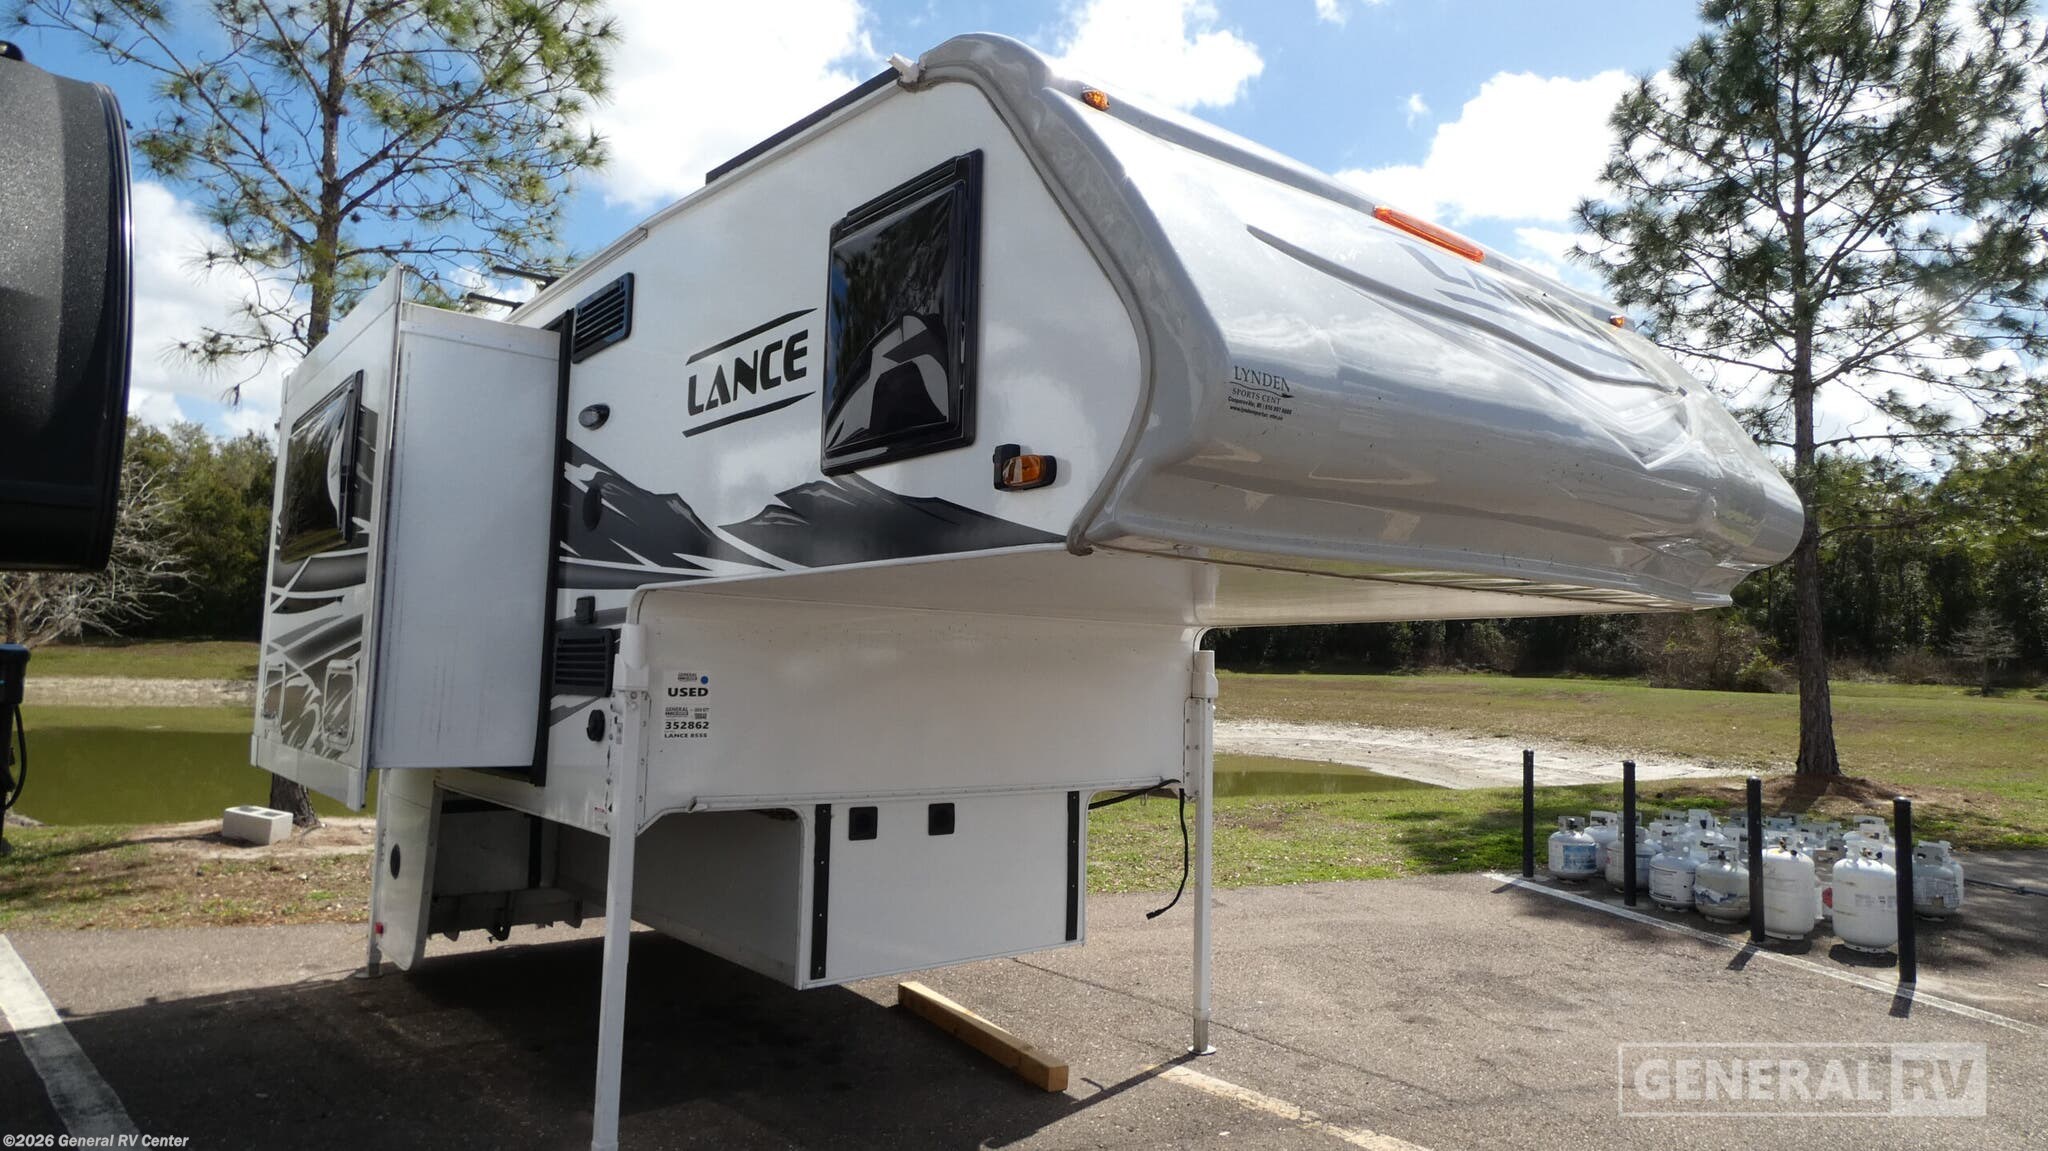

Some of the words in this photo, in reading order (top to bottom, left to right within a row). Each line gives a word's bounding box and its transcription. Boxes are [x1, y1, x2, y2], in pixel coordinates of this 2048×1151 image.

[687, 329, 809, 416] LANCE
[1234, 366, 1290, 392] LYNDEN
[1232, 388, 1260, 401] SPORTS
[667, 687, 709, 697] USED
[665, 721, 710, 730] 352862
